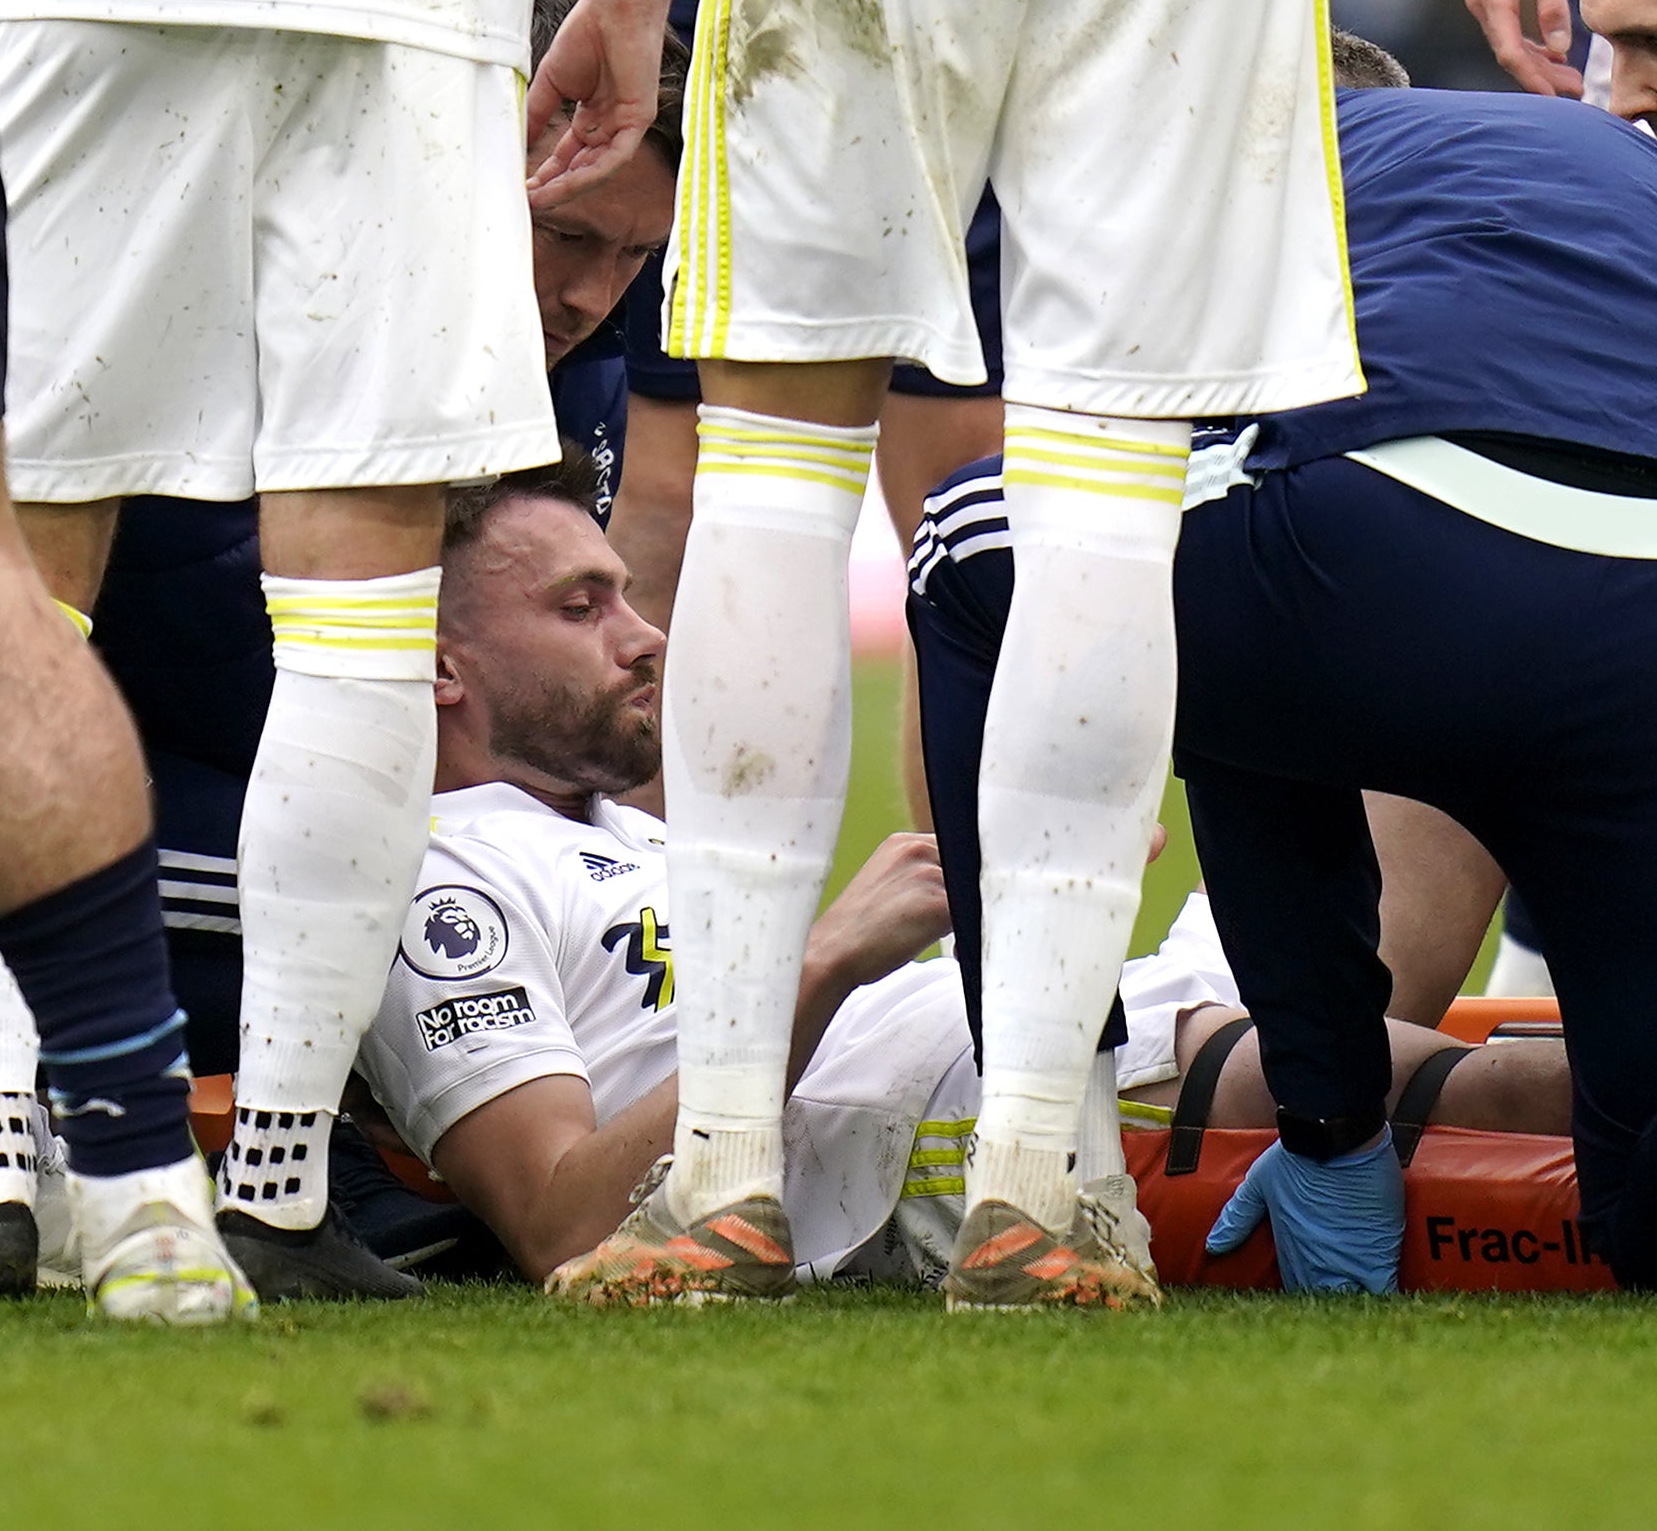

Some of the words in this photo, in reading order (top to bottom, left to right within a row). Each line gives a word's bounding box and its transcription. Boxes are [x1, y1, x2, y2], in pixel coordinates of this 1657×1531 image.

[457, 954, 488, 972] Premier
[486, 925, 499, 956] League
[417, 1007, 452, 1034] No
[454, 993, 518, 1019] room
[459, 1007, 535, 1034] racism
